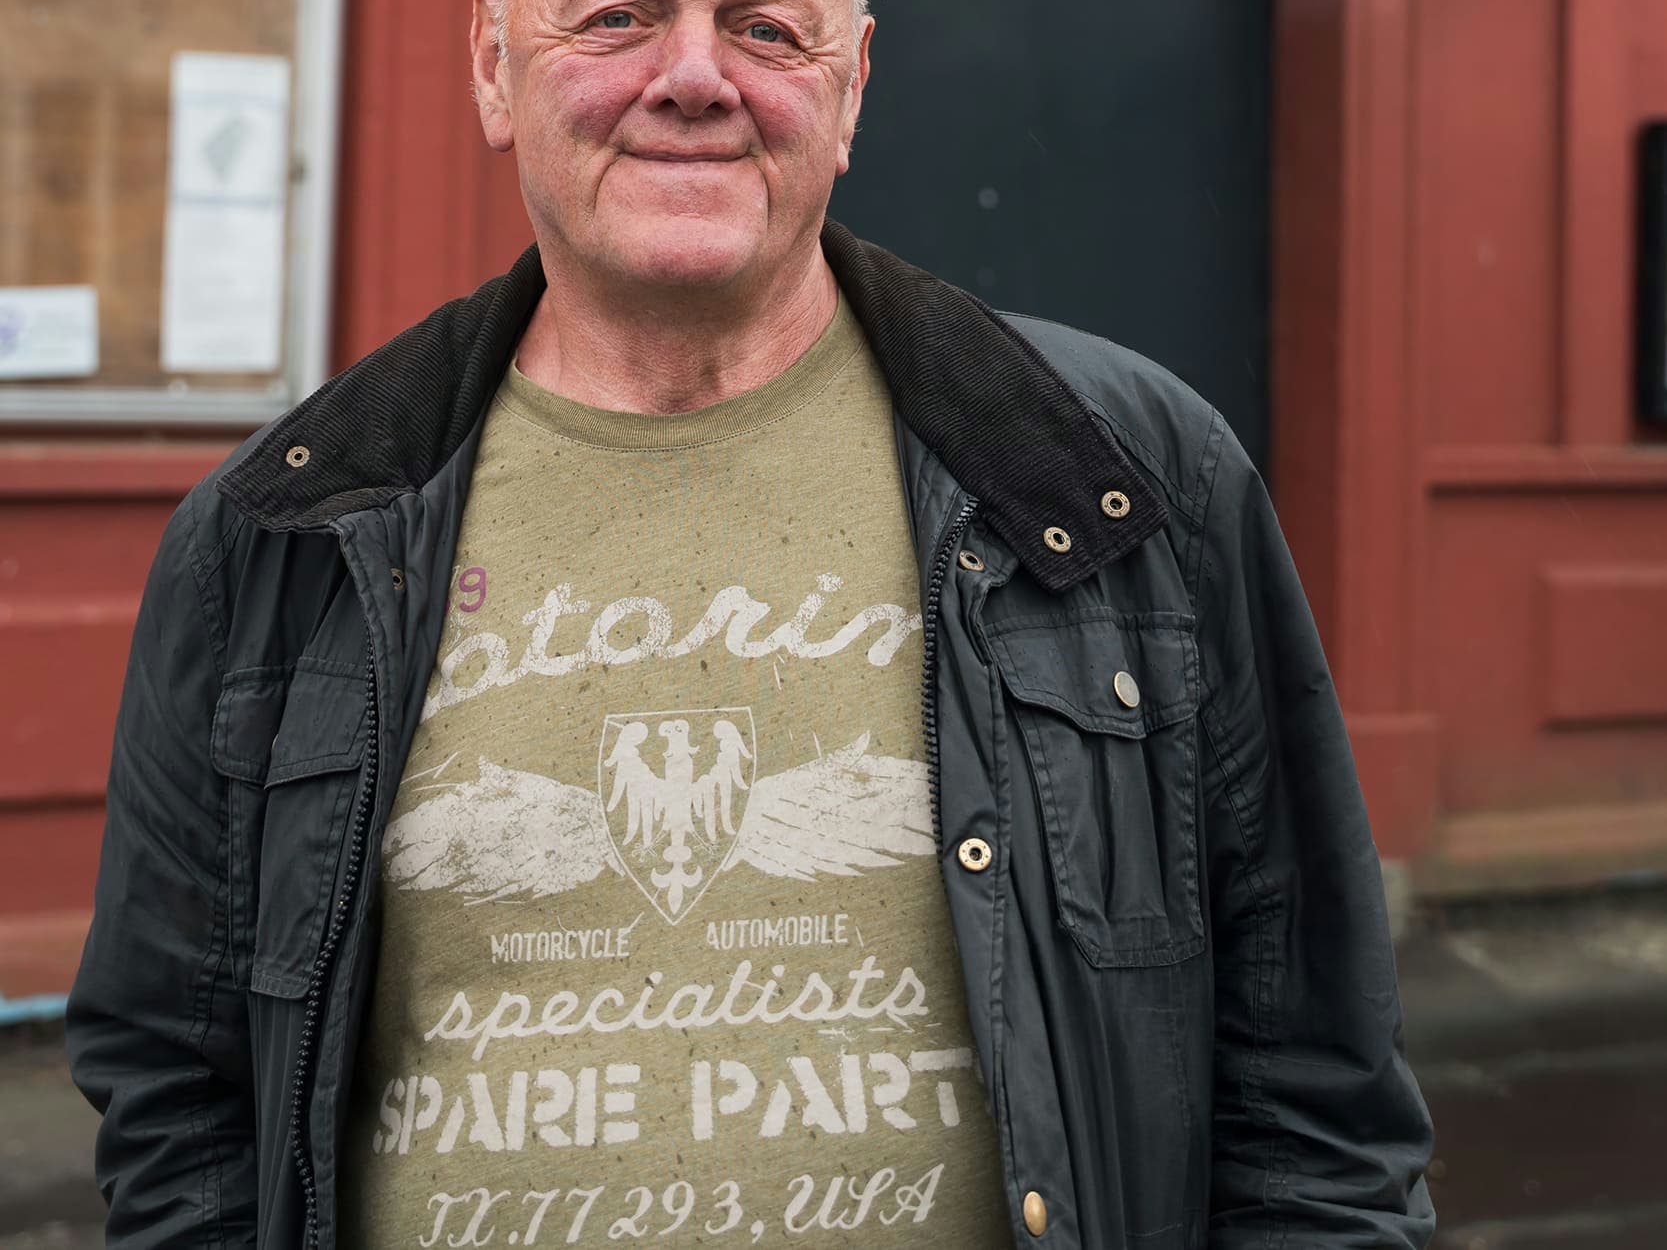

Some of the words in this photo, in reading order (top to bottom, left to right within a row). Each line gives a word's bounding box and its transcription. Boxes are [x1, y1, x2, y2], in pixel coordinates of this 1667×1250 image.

[490, 928, 630, 963] MOTORCYCLE
[705, 914, 848, 950] AUTOMOBILE
[424, 955, 929, 1061] specialists
[372, 1062, 641, 1155] SPARE
[691, 1047, 986, 1140] PART
[784, 1163, 945, 1233] USA
